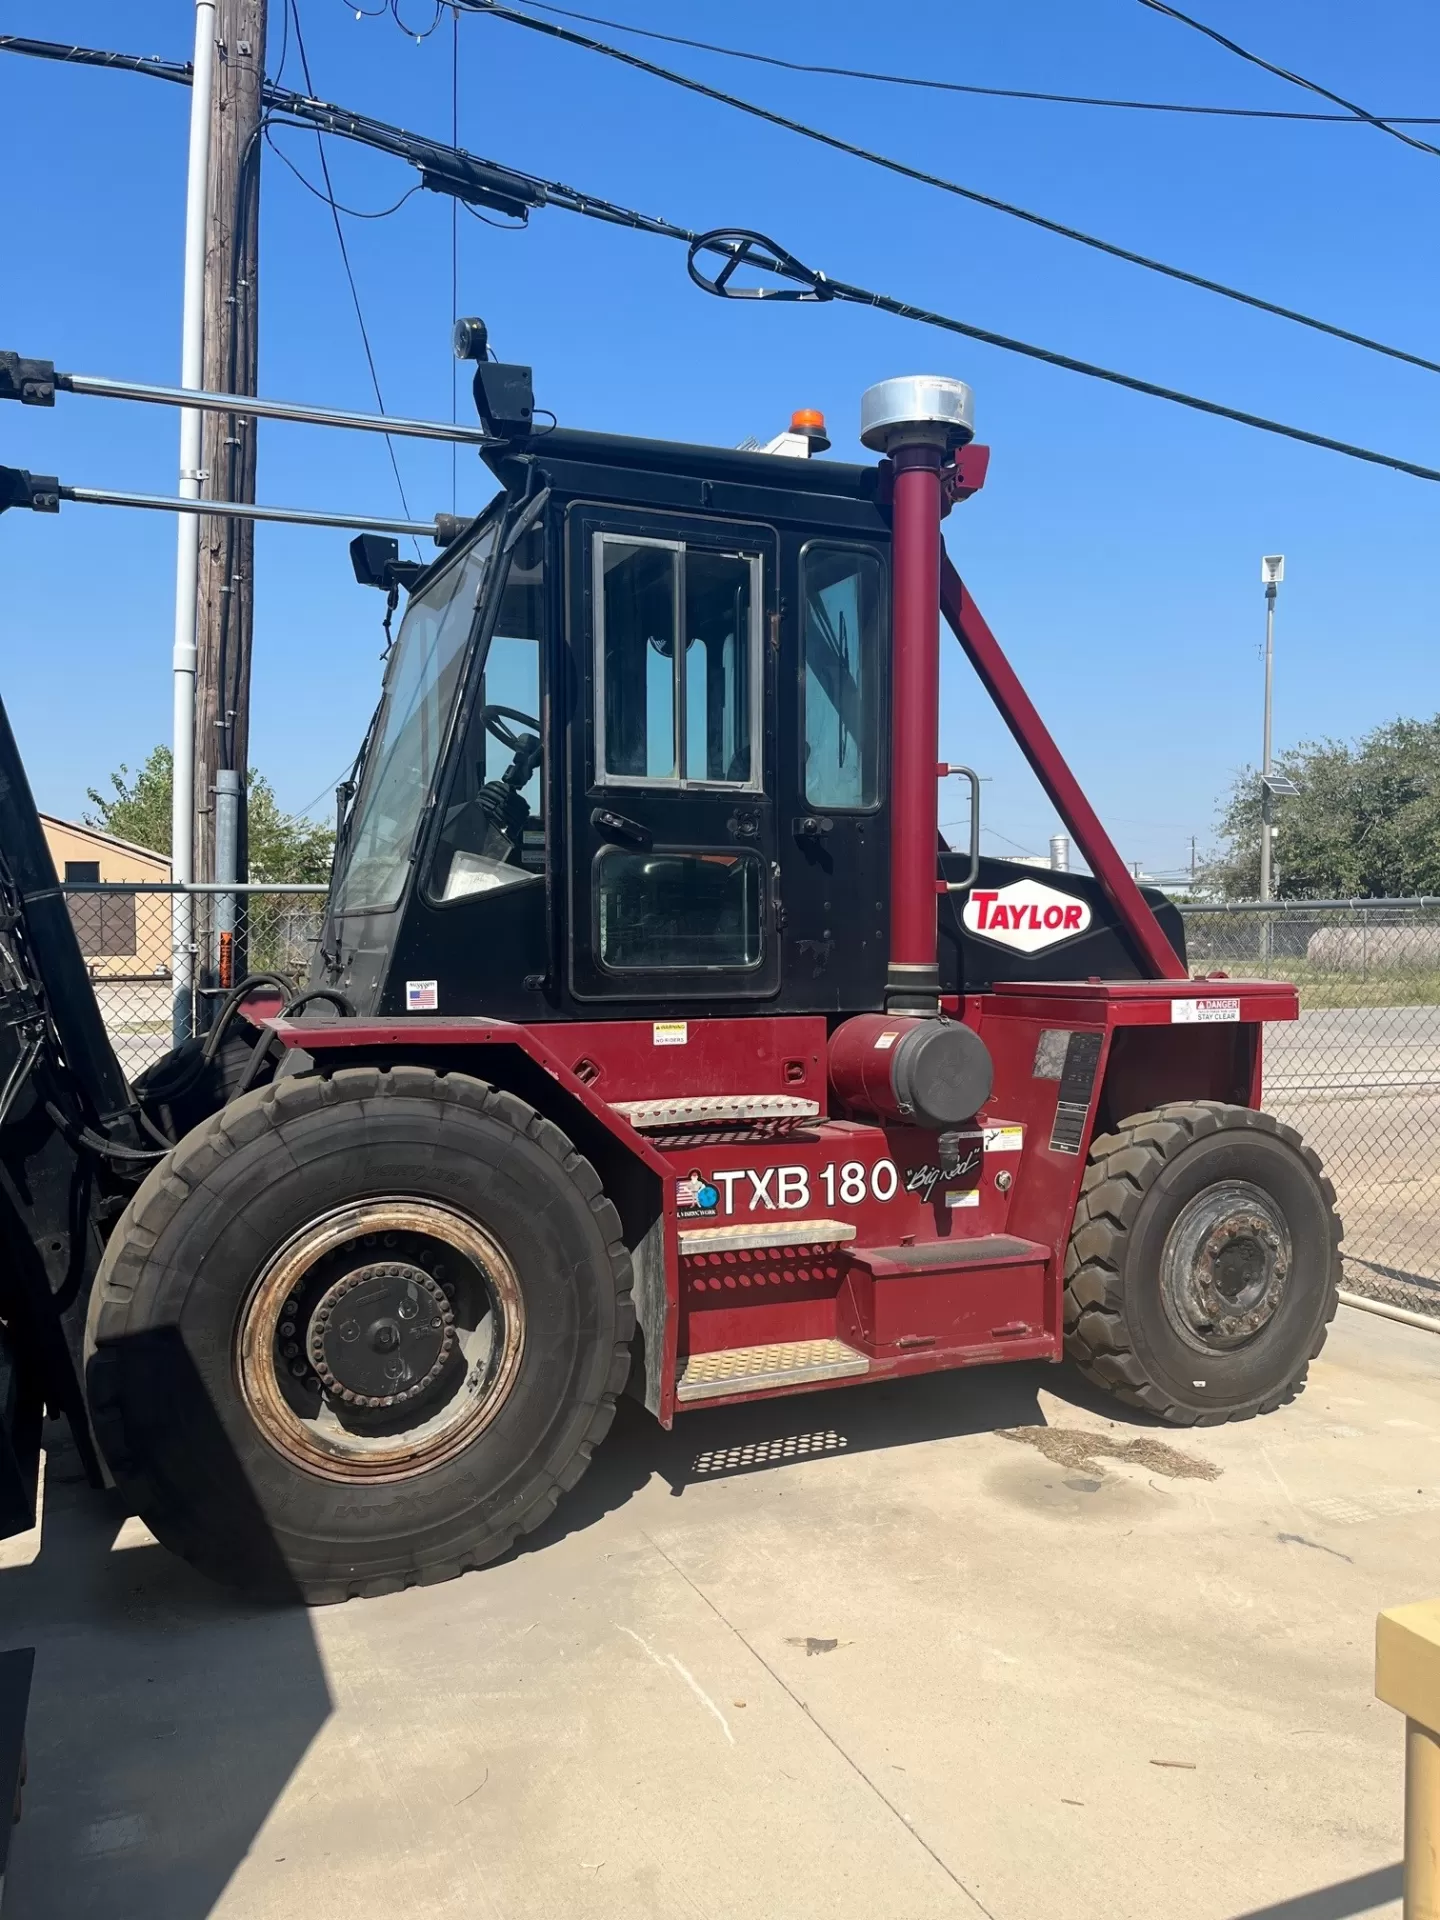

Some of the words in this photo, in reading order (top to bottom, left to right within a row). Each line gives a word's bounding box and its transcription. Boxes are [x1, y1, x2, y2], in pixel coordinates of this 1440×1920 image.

[971, 892, 1083, 930] TAYLOR
[1206, 1000, 1239, 1009] DANGER
[713, 1166, 809, 1215] TXB
[819, 1159, 898, 1207] 180
